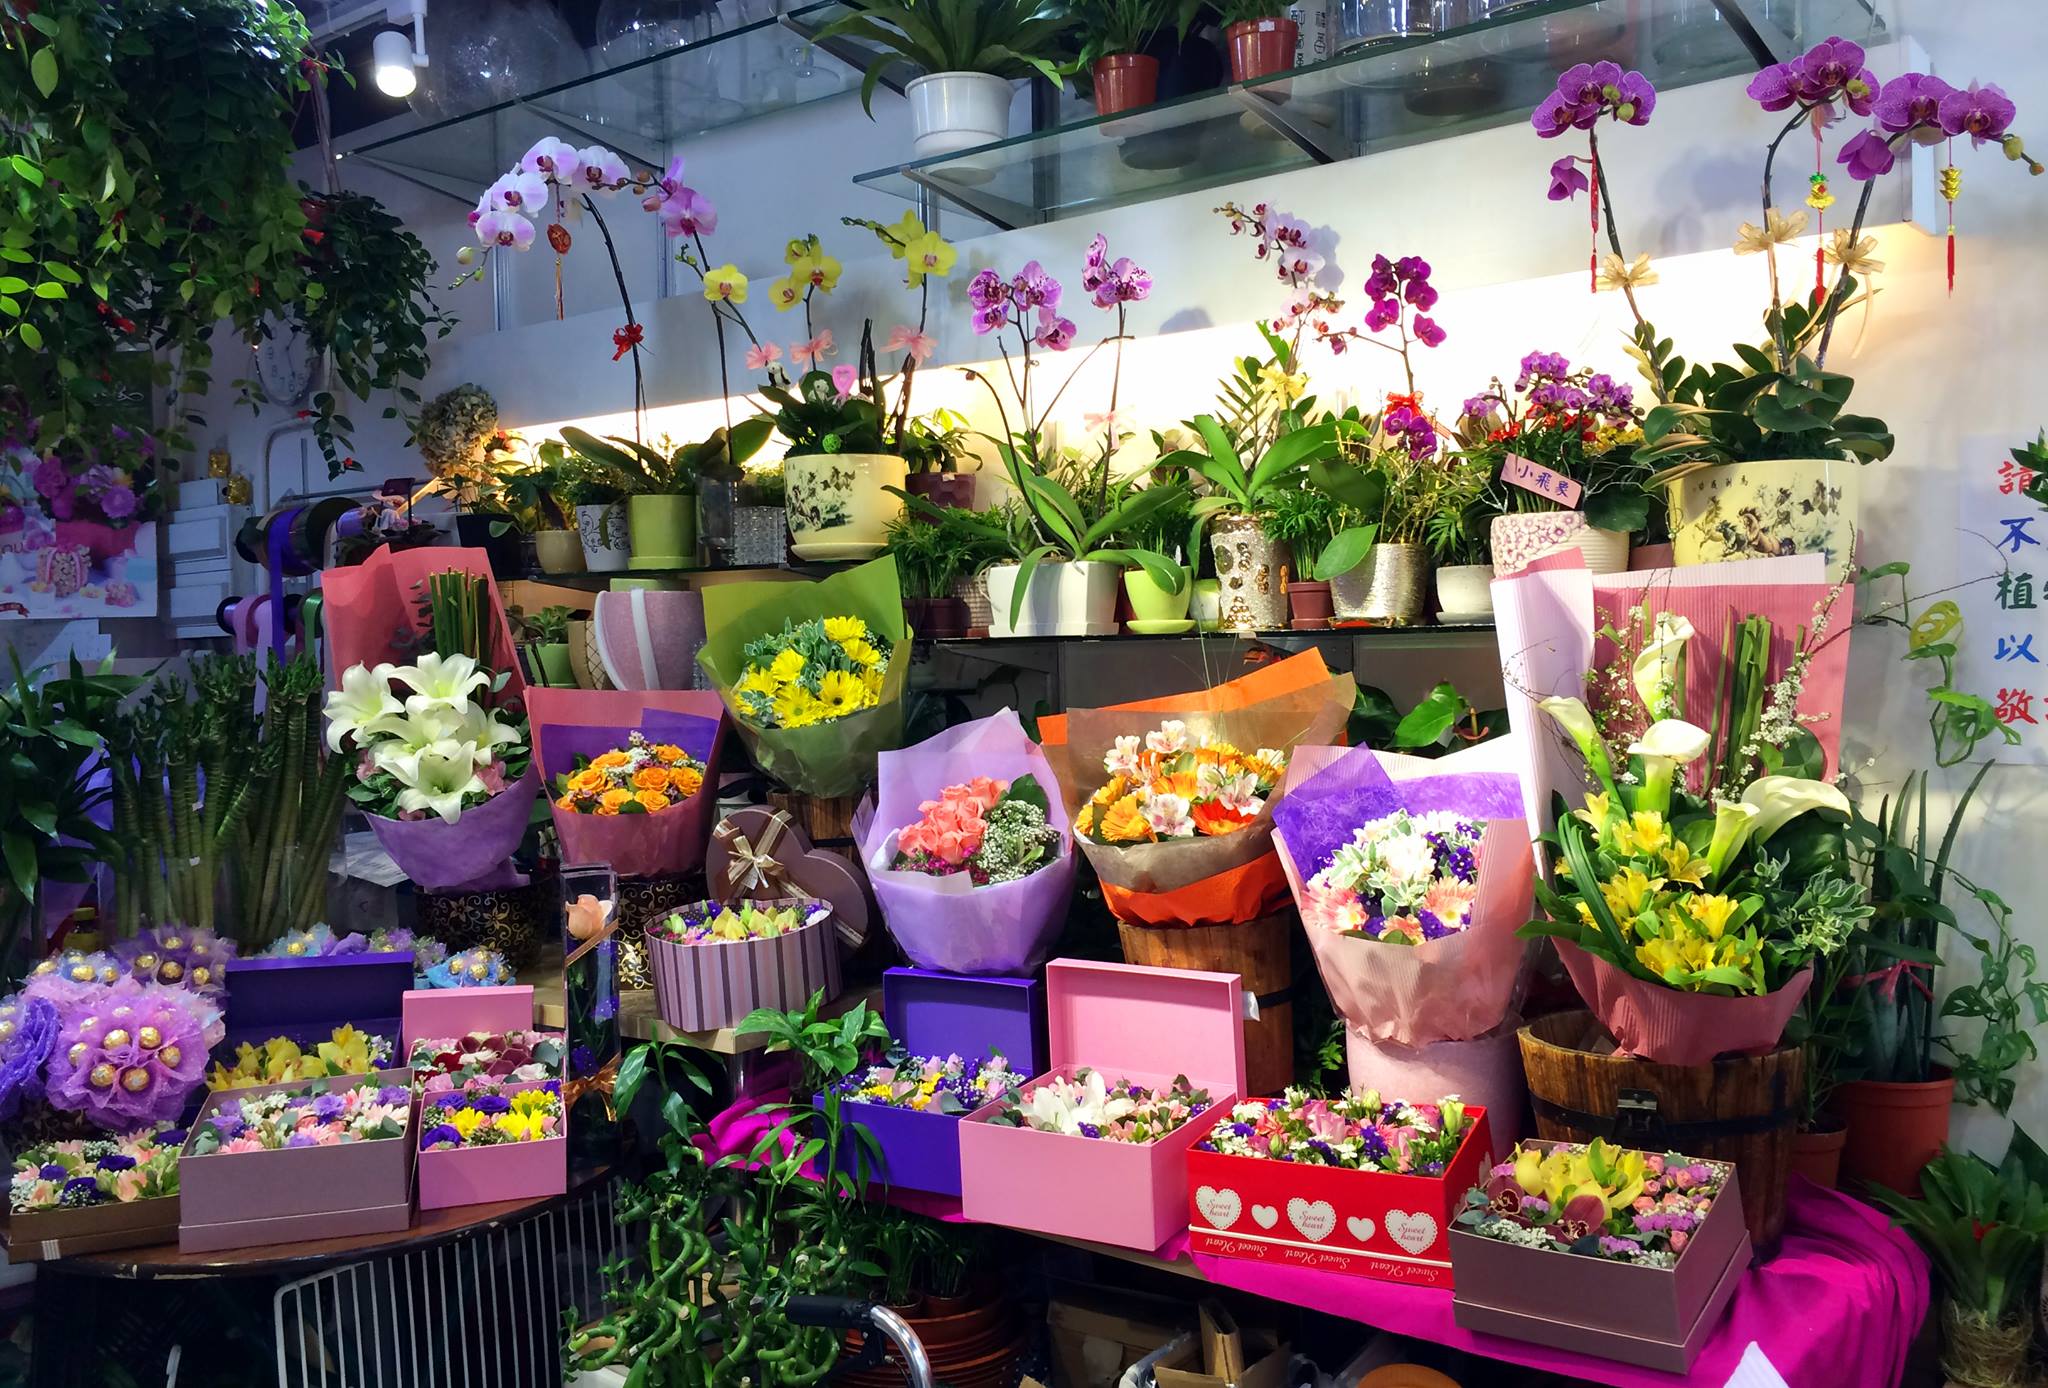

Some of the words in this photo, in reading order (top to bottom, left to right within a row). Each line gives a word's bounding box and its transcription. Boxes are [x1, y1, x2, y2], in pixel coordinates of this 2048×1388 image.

[1994, 572, 2048, 610] 植
[1994, 688, 2048, 725] 敬
[1206, 1198, 1232, 1210] Sweet
[1209, 1207, 1230, 1217] heart
[1299, 1210, 1326, 1222] Sweet
[1302, 1219, 1324, 1230] heart
[1398, 1222, 1426, 1234] Sweet
[1400, 1232, 1424, 1242] heart
[1205, 1237, 1236, 1253] Heart
[1237, 1241, 1267, 1257] Sweet
[1284, 1249, 1317, 1265] Heart
[1318, 1254, 1350, 1270] Sweet
[1369, 1261, 1404, 1277] Heart
[1406, 1267, 1439, 1282] Sweet
